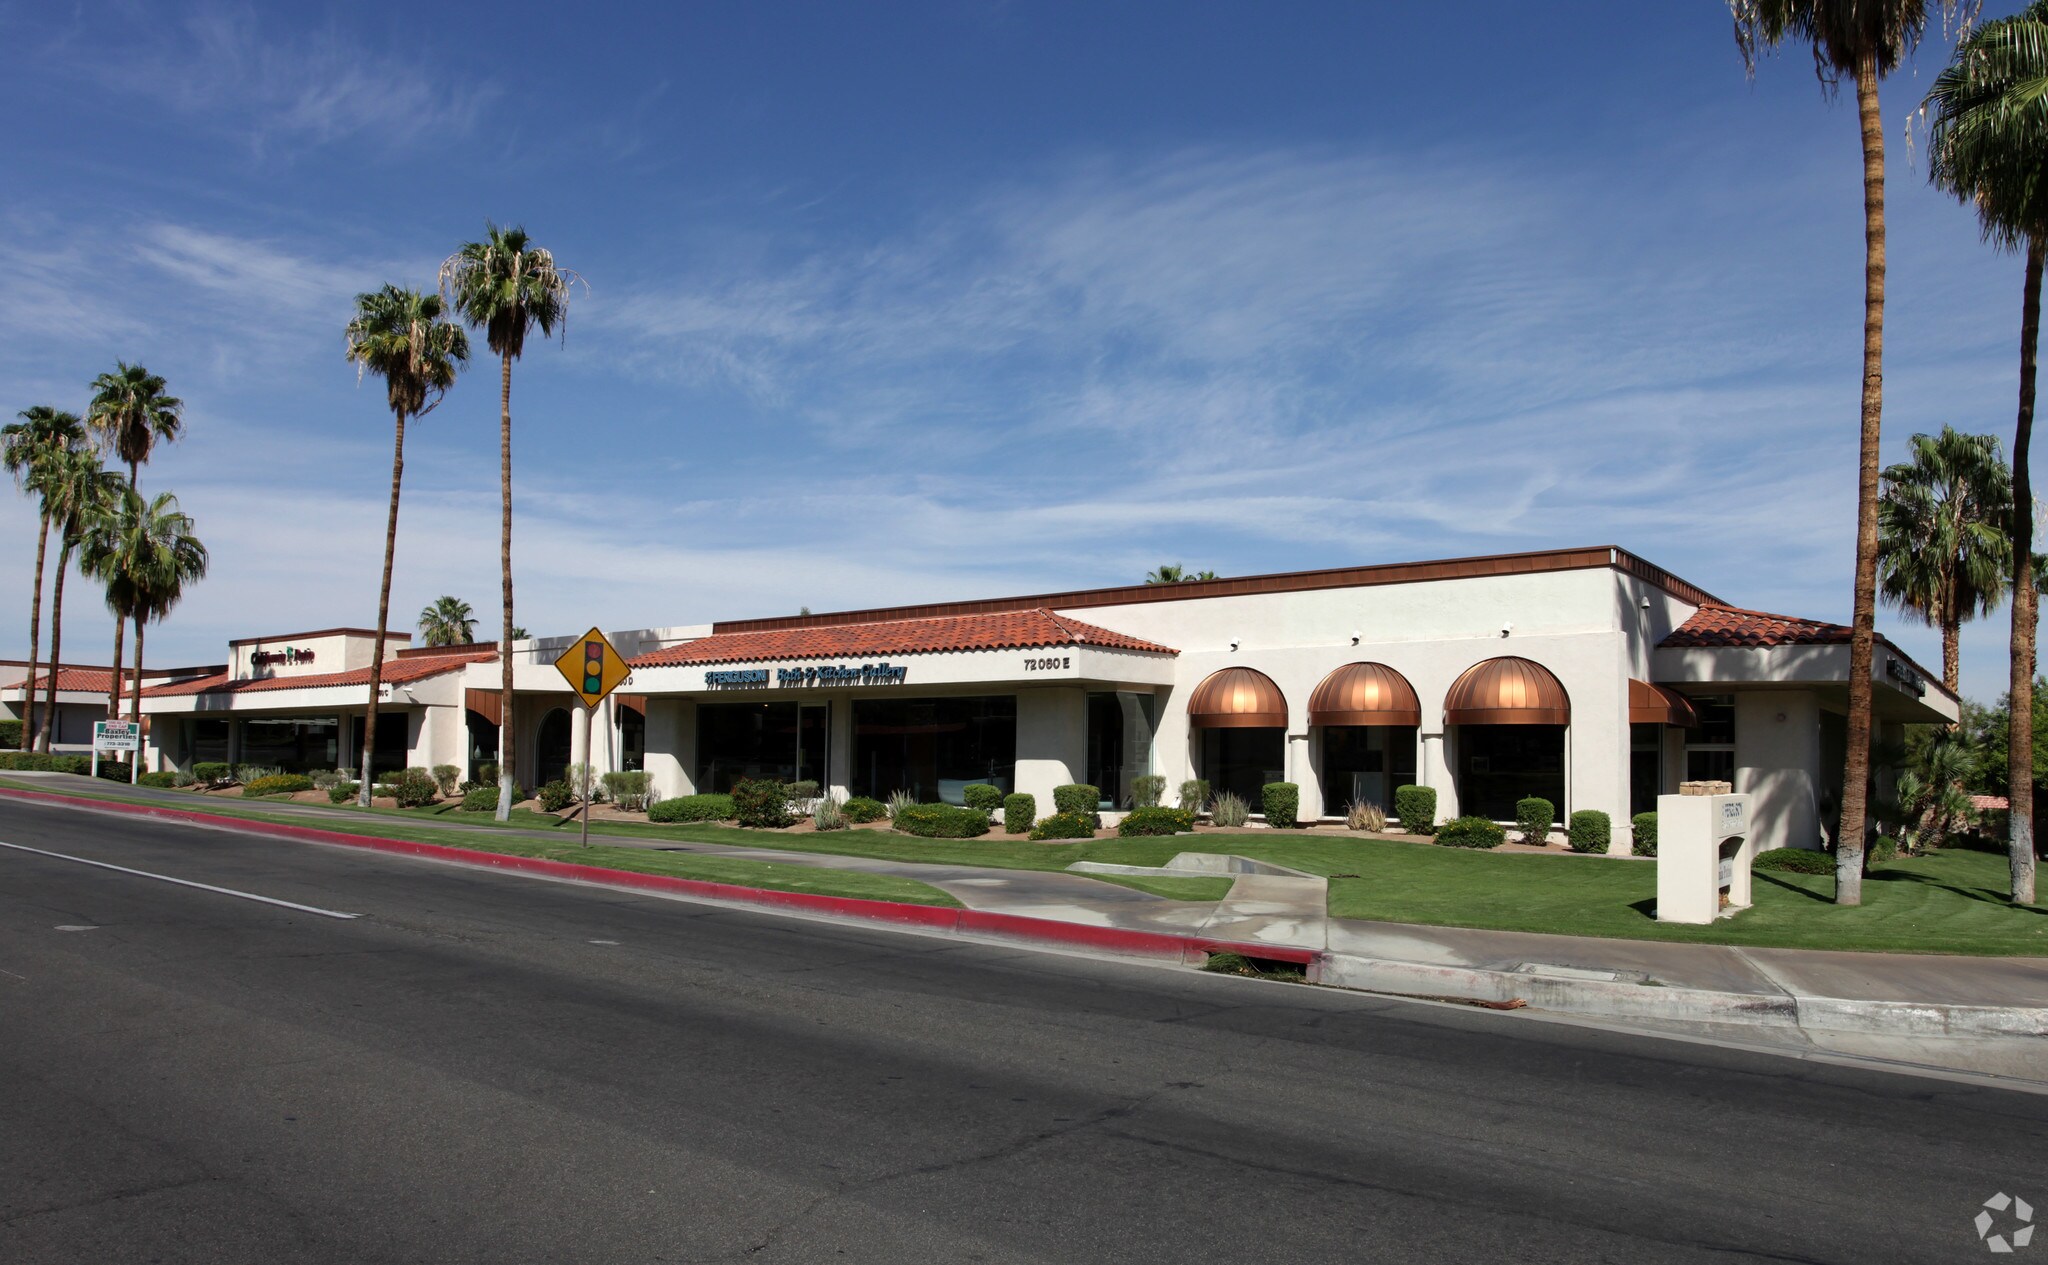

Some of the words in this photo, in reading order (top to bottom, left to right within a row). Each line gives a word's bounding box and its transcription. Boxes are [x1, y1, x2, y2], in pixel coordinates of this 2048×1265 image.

[1063, 657, 1070, 669] E
[712, 669, 769, 684] FERGUSON
[777, 667, 801, 681] Bath
[804, 667, 814, 680] &
[816, 664, 859, 679] Kitchen
[860, 662, 905, 680] Gallery
